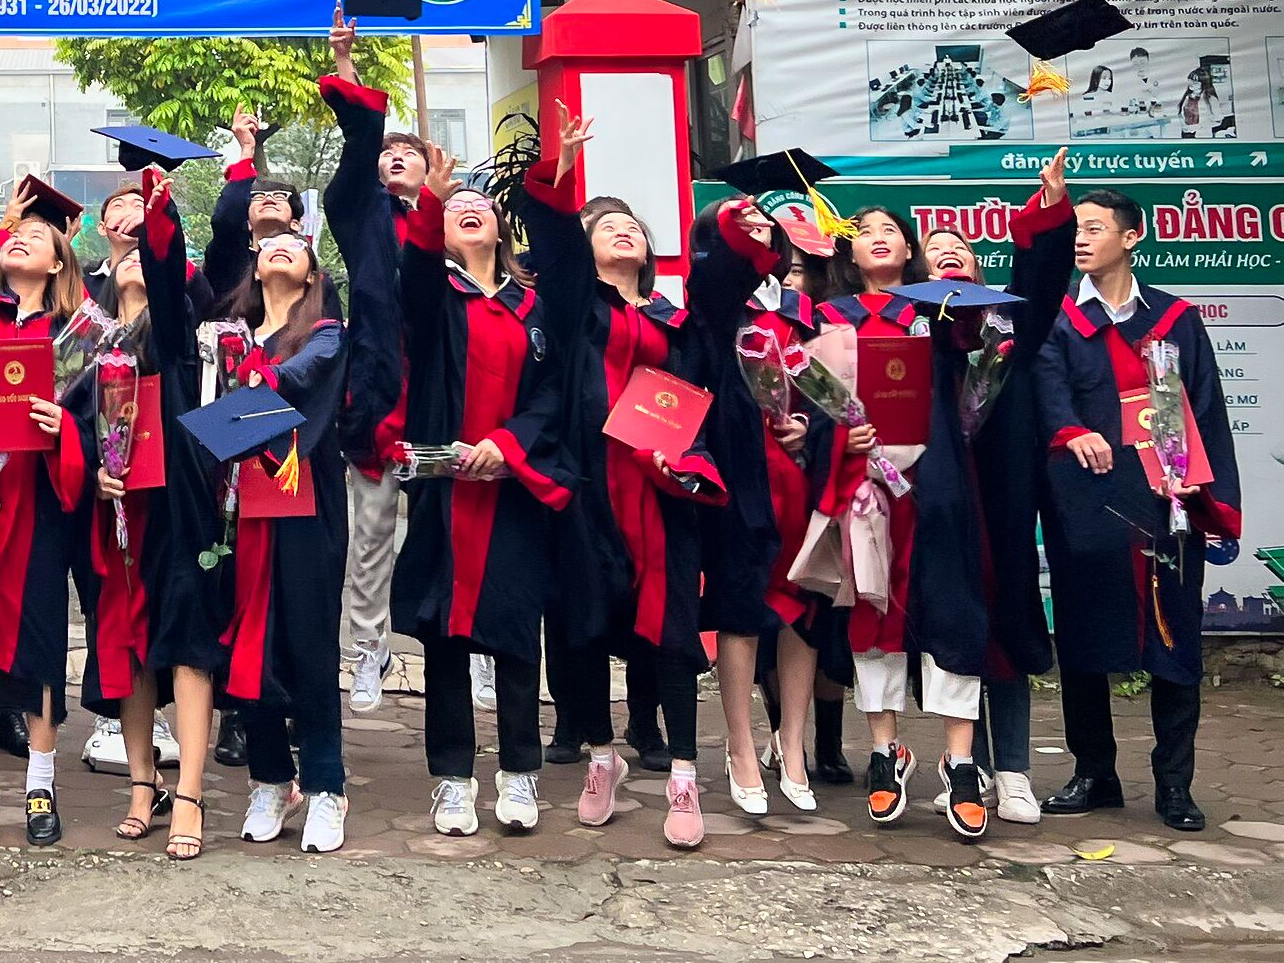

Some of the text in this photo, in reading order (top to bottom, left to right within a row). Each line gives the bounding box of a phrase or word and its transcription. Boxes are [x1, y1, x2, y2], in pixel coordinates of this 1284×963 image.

[1088, 153, 1129, 174] trực
[1134, 149, 1195, 173] tuyến
[1153, 188, 1263, 243] ĐẲNG
[1155, 250, 1191, 269] LÀM
[1194, 249, 1234, 269] PHẢI
[1237, 253, 1272, 270] HỌC
